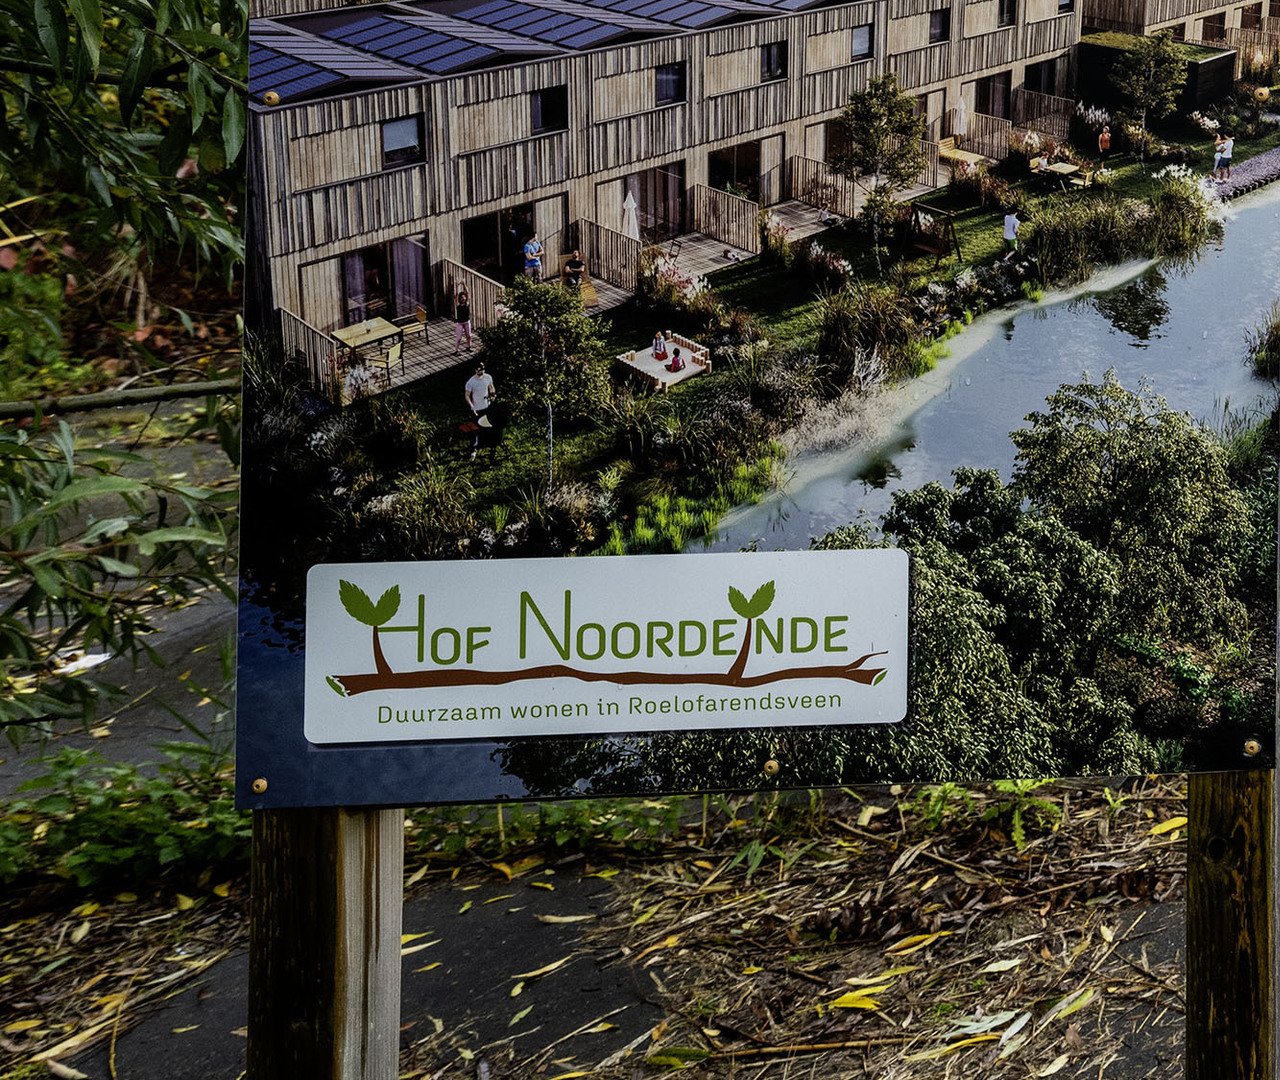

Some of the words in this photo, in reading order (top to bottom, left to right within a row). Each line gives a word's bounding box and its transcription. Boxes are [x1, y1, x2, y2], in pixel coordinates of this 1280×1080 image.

[378, 705, 501, 724] Duurzaam
[510, 703, 588, 719] wonen
[597, 698, 619, 716] in
[629, 692, 841, 715] Roelofarendsveen
